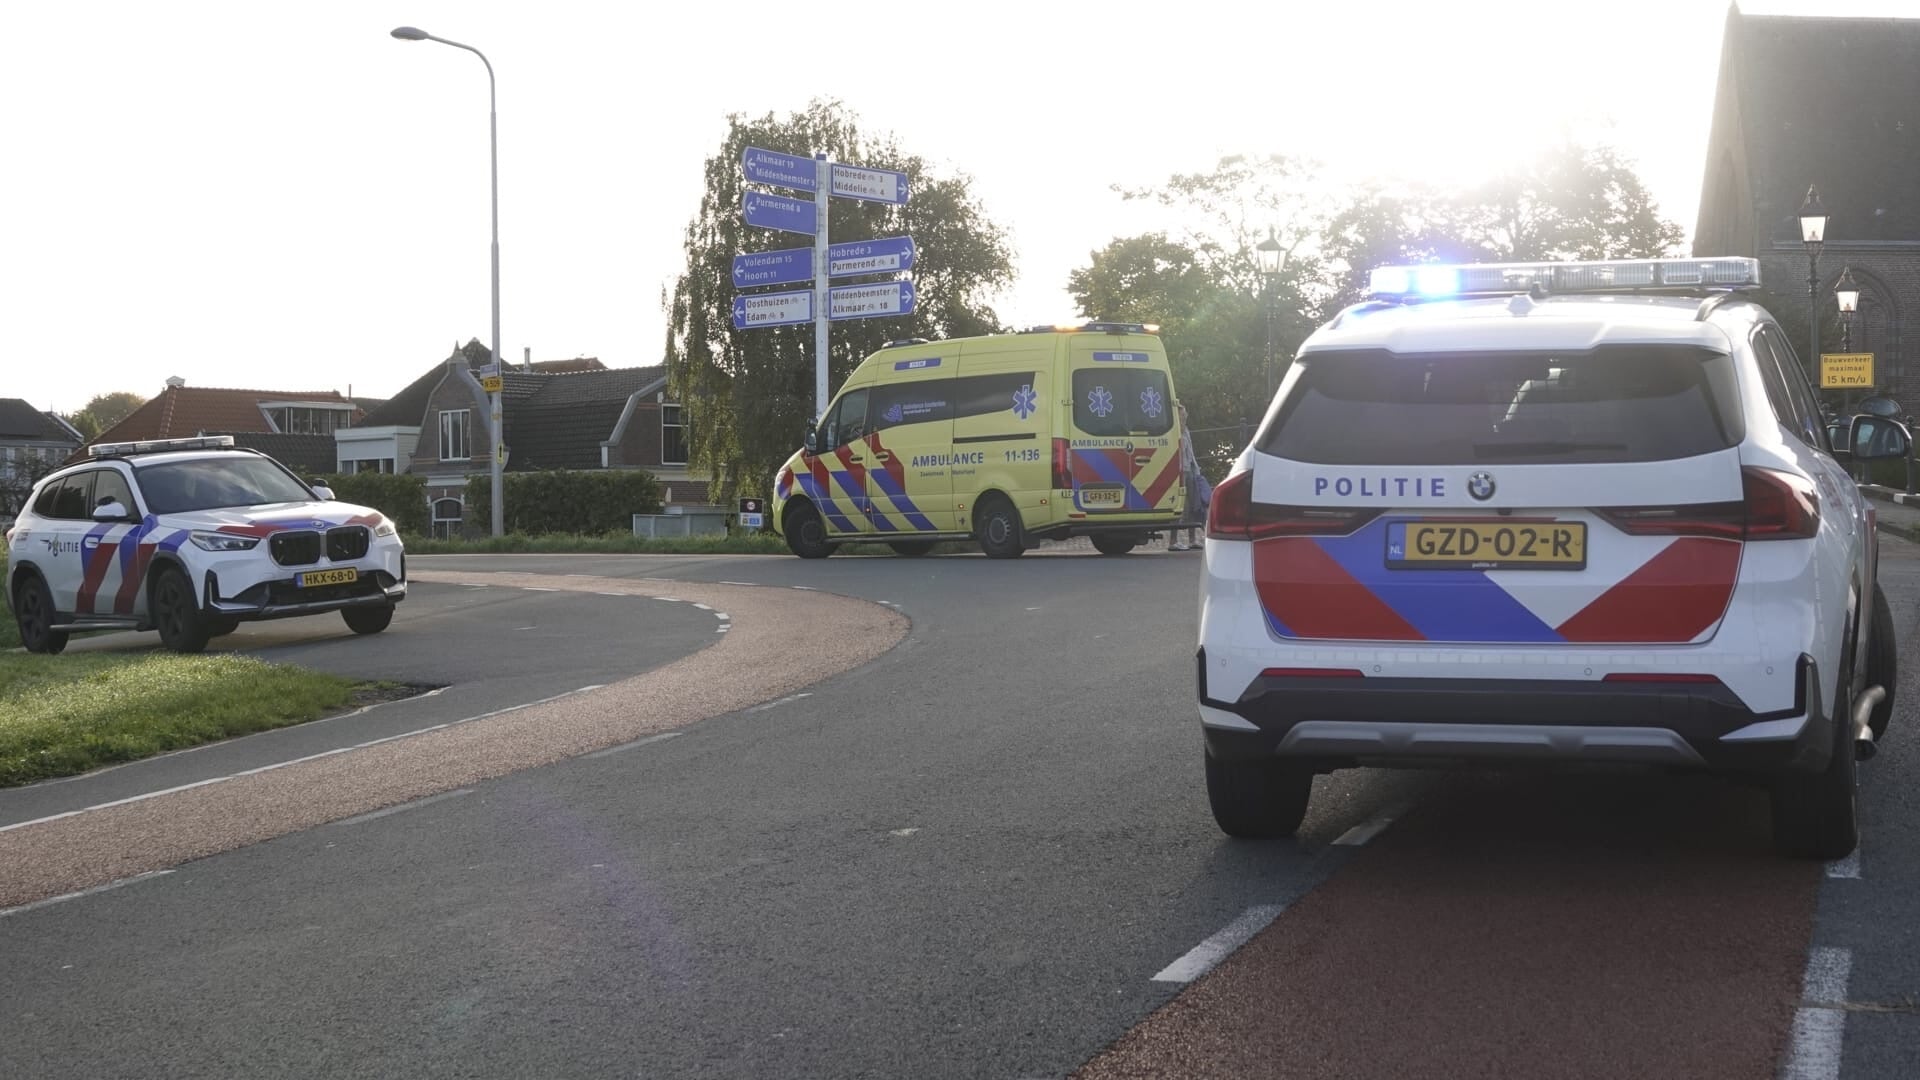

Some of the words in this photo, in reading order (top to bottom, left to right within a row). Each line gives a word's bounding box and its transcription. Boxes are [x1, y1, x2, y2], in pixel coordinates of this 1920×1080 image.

[756, 153, 785, 166] Alkmaar
[756, 167, 810, 185] Middenbeemster
[834, 168, 866, 180] Hobrede
[834, 181, 868, 193] Middelie
[756, 196, 795, 211] Purmerend
[830, 247, 865, 258] Hobrede
[744, 255, 783, 267] Volendam
[784, 255, 793, 263] 15
[832, 259, 876, 271] Purmerend
[744, 271, 768, 281] Hoorn
[832, 288, 890, 300] Middenbeemster
[746, 298, 789, 309] Oosthuizen
[832, 303, 866, 314] Alkmaar
[746, 313, 767, 322] Edam
[1827, 375, 1838, 384] 15
[1841, 375, 1866, 384] km/u
[1072, 439, 1125, 447] AMBULANCE
[1147, 438, 1168, 447] 11-136
[912, 452, 984, 468] AMBULANCE
[1005, 448, 1040, 463] 11-136
[1315, 477, 1445, 497] POLITIE
[46, 540, 79, 556] POLITIE
[1416, 528, 1572, 557] GZD-02-R
[1390, 546, 1403, 554] NL
[304, 570, 354, 585] HKX-68-D
